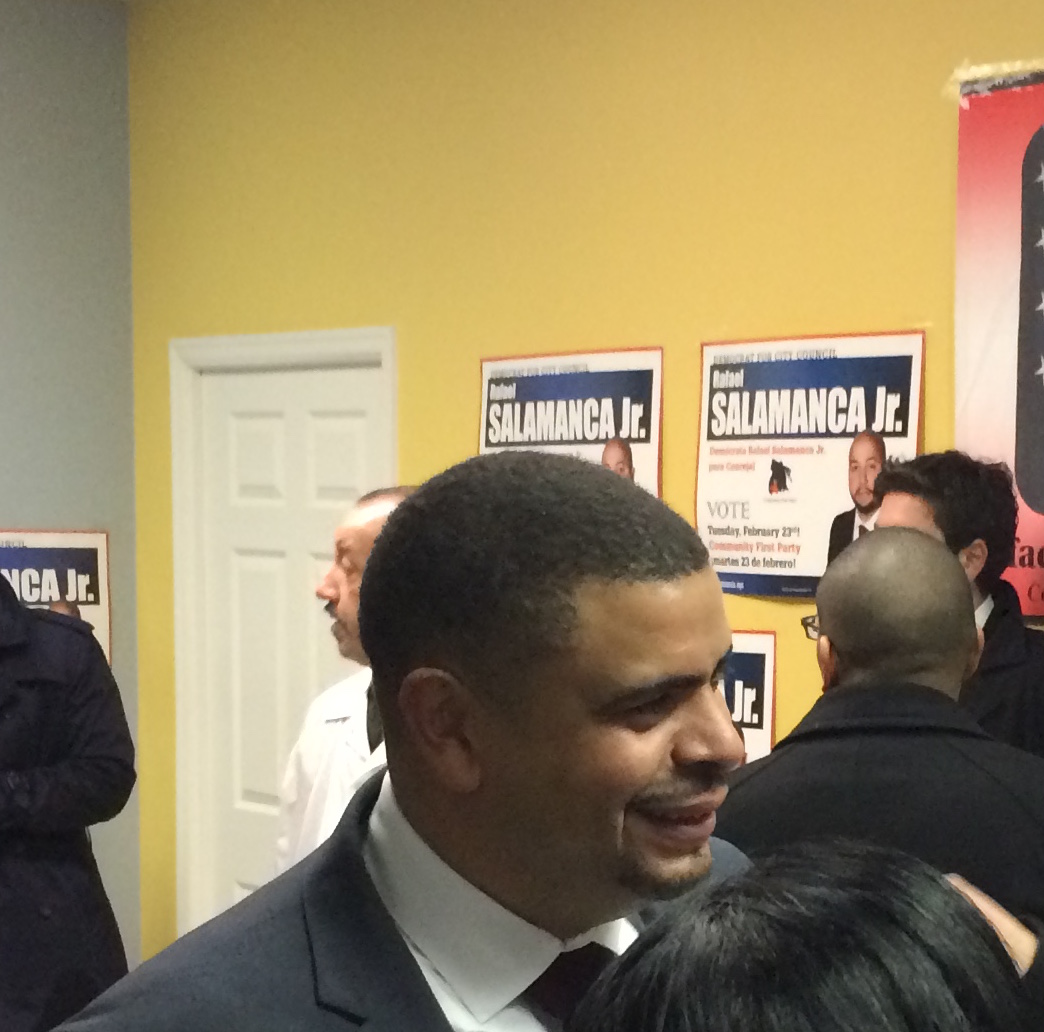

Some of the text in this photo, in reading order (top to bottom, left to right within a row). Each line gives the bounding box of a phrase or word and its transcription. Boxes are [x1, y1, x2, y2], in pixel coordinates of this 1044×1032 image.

[488, 396, 646, 443] SALAMANCA Jr.
[711, 385, 902, 436] SALAMANCA Jr.
[707, 501, 750, 519] VOTE
[65, 569, 95, 602] Jr.
[732, 680, 759, 724] Jr.
